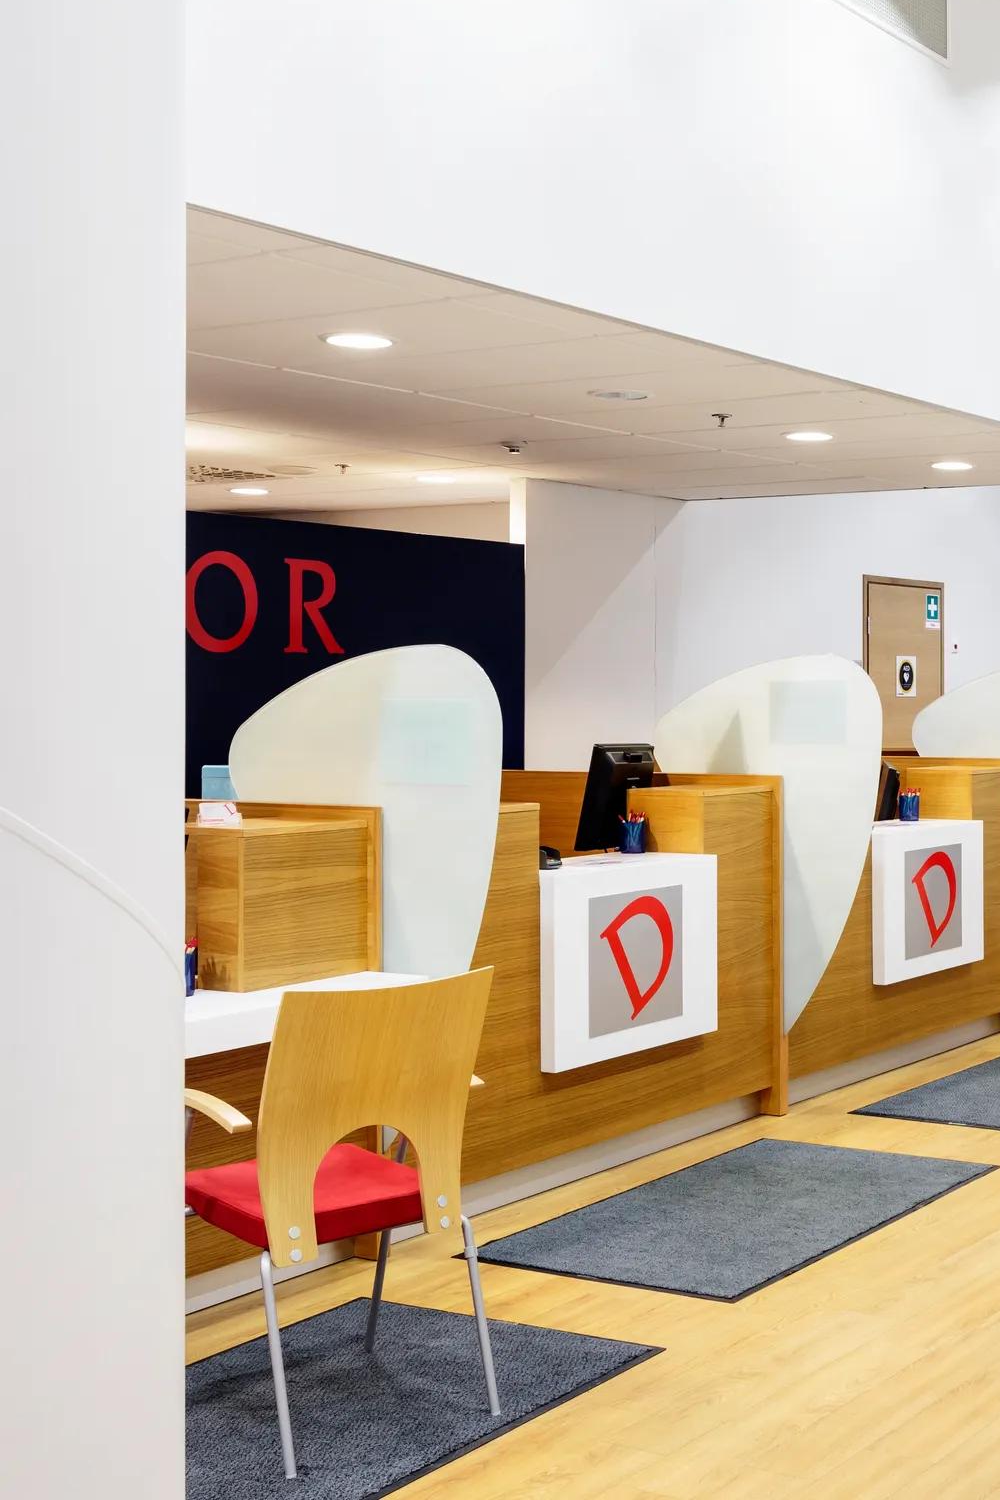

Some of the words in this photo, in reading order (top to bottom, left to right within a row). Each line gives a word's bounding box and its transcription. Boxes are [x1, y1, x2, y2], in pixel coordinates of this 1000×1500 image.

[186, 550, 345, 655] OR
[911, 850, 958, 949] D
[599, 894, 675, 1021] D
